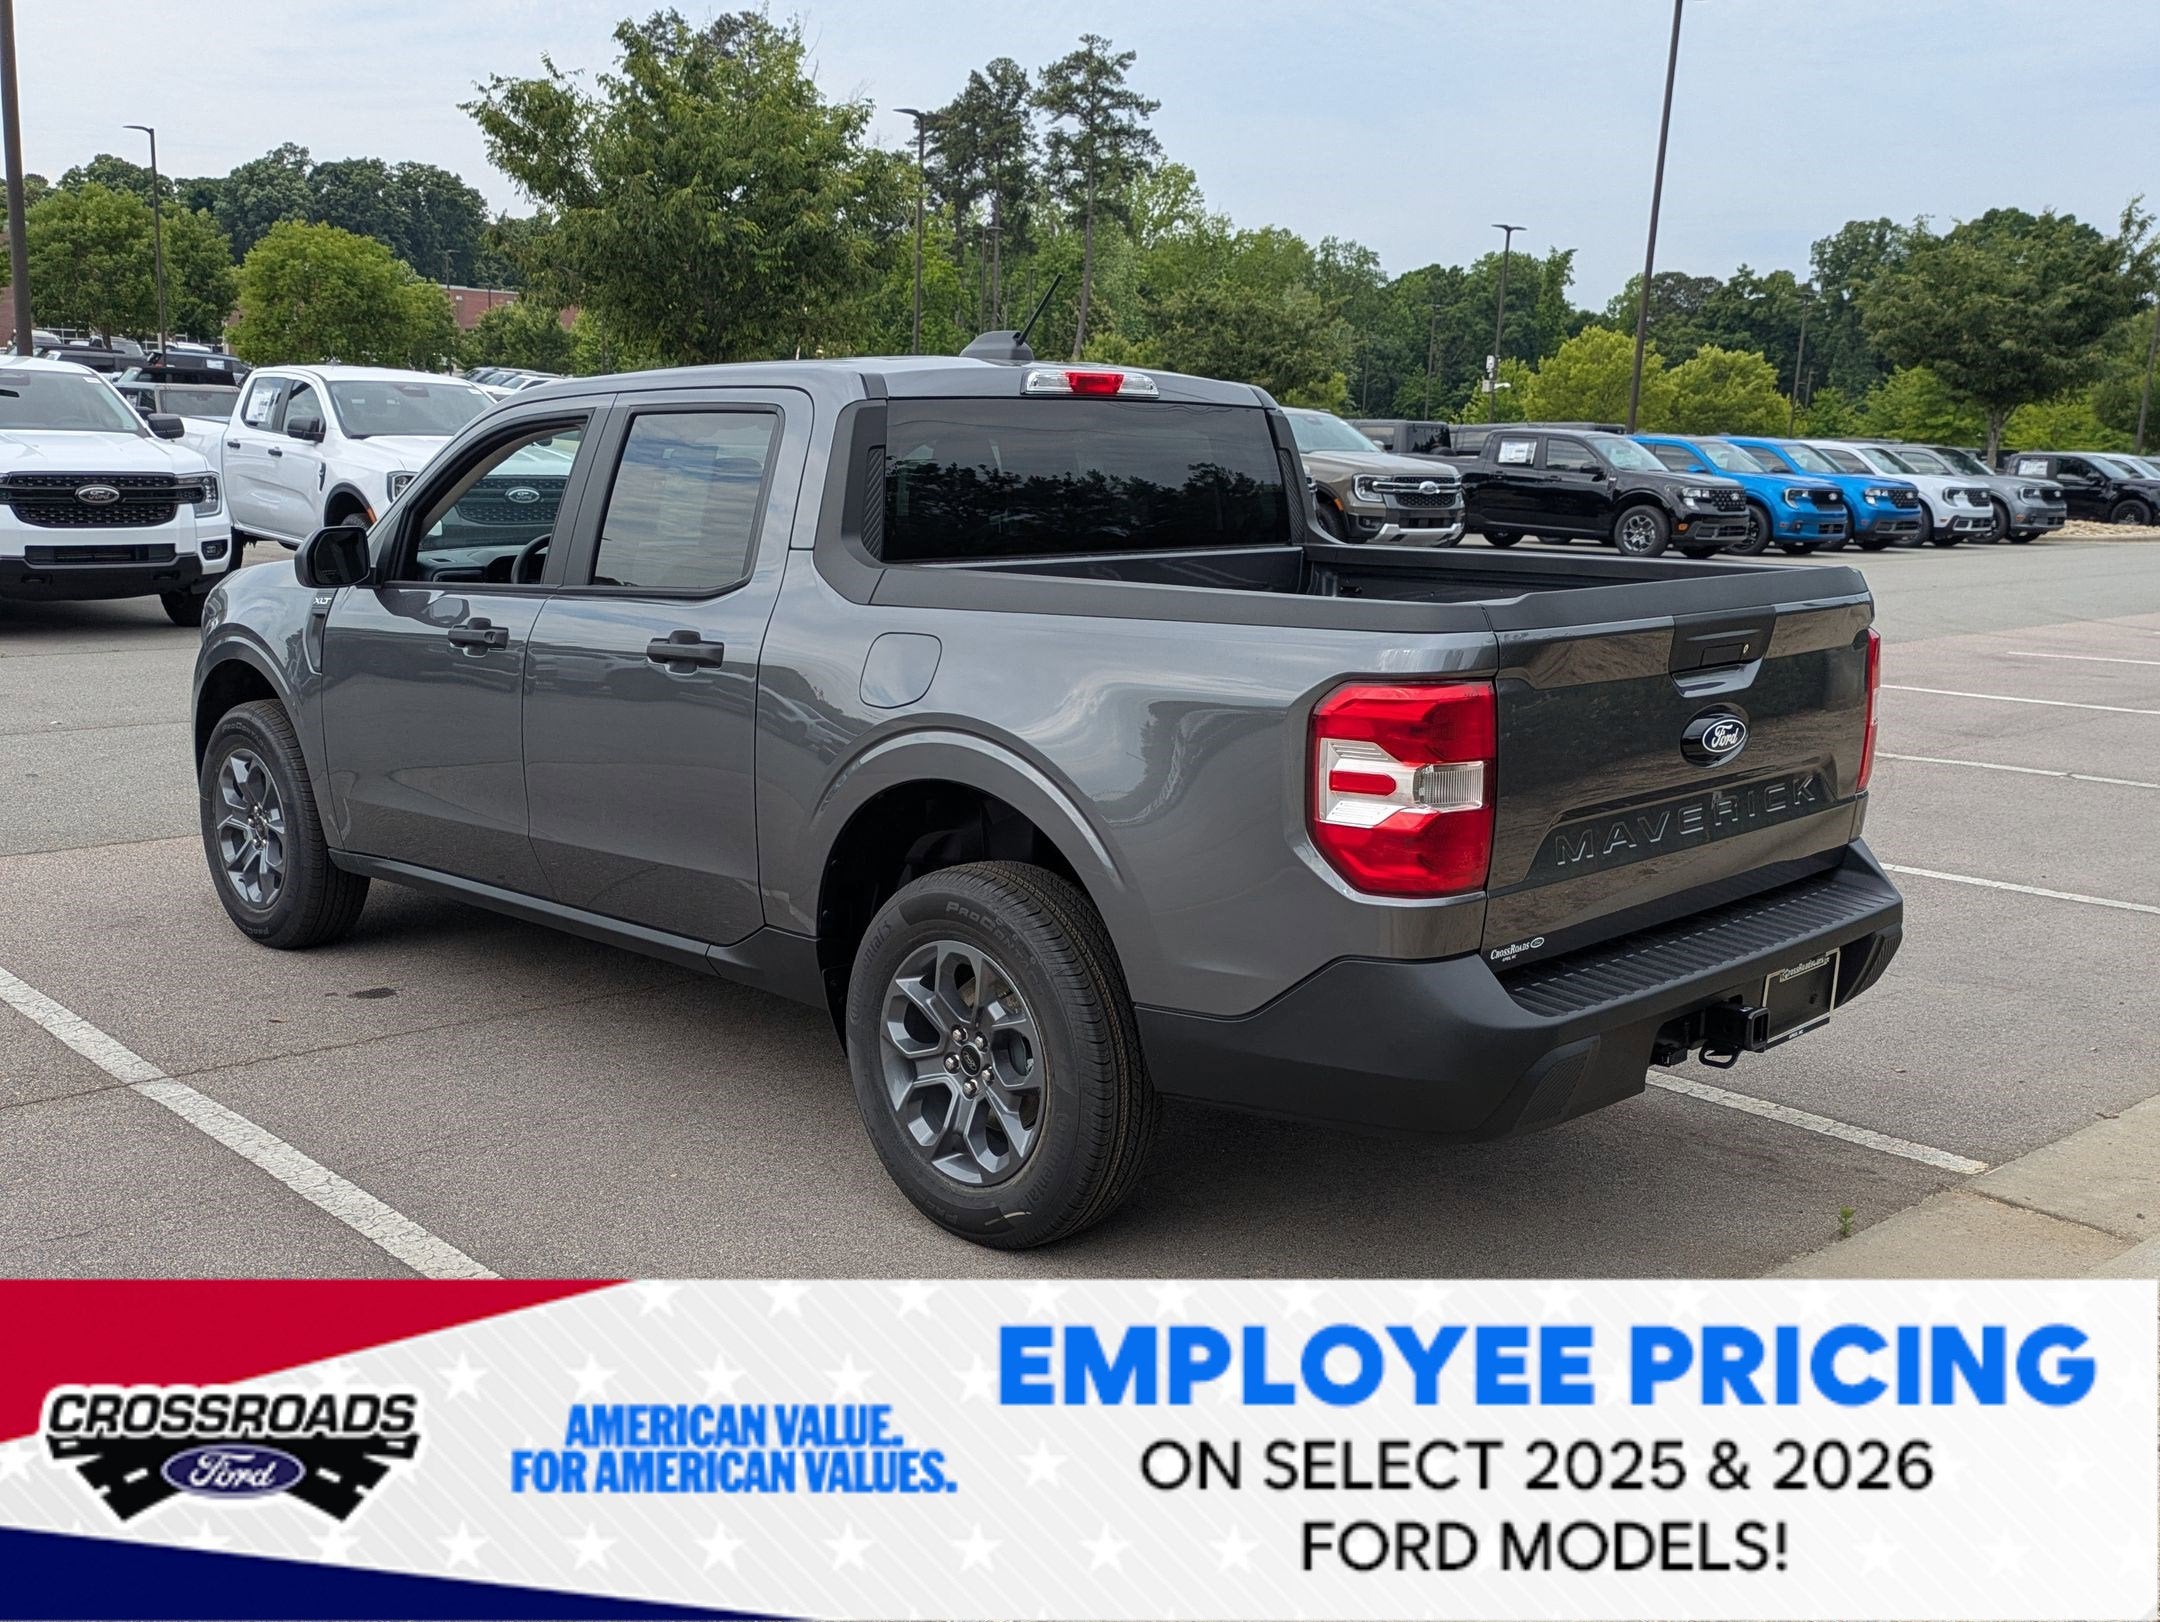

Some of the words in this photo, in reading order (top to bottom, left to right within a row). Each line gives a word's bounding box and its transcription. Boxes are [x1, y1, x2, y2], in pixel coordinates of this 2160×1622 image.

[312, 597, 332, 605] XLT
[1711, 724, 1740, 748] Ford
[1554, 775, 1816, 866] MAVERICK
[945, 901, 1041, 988] PROCONTAC
